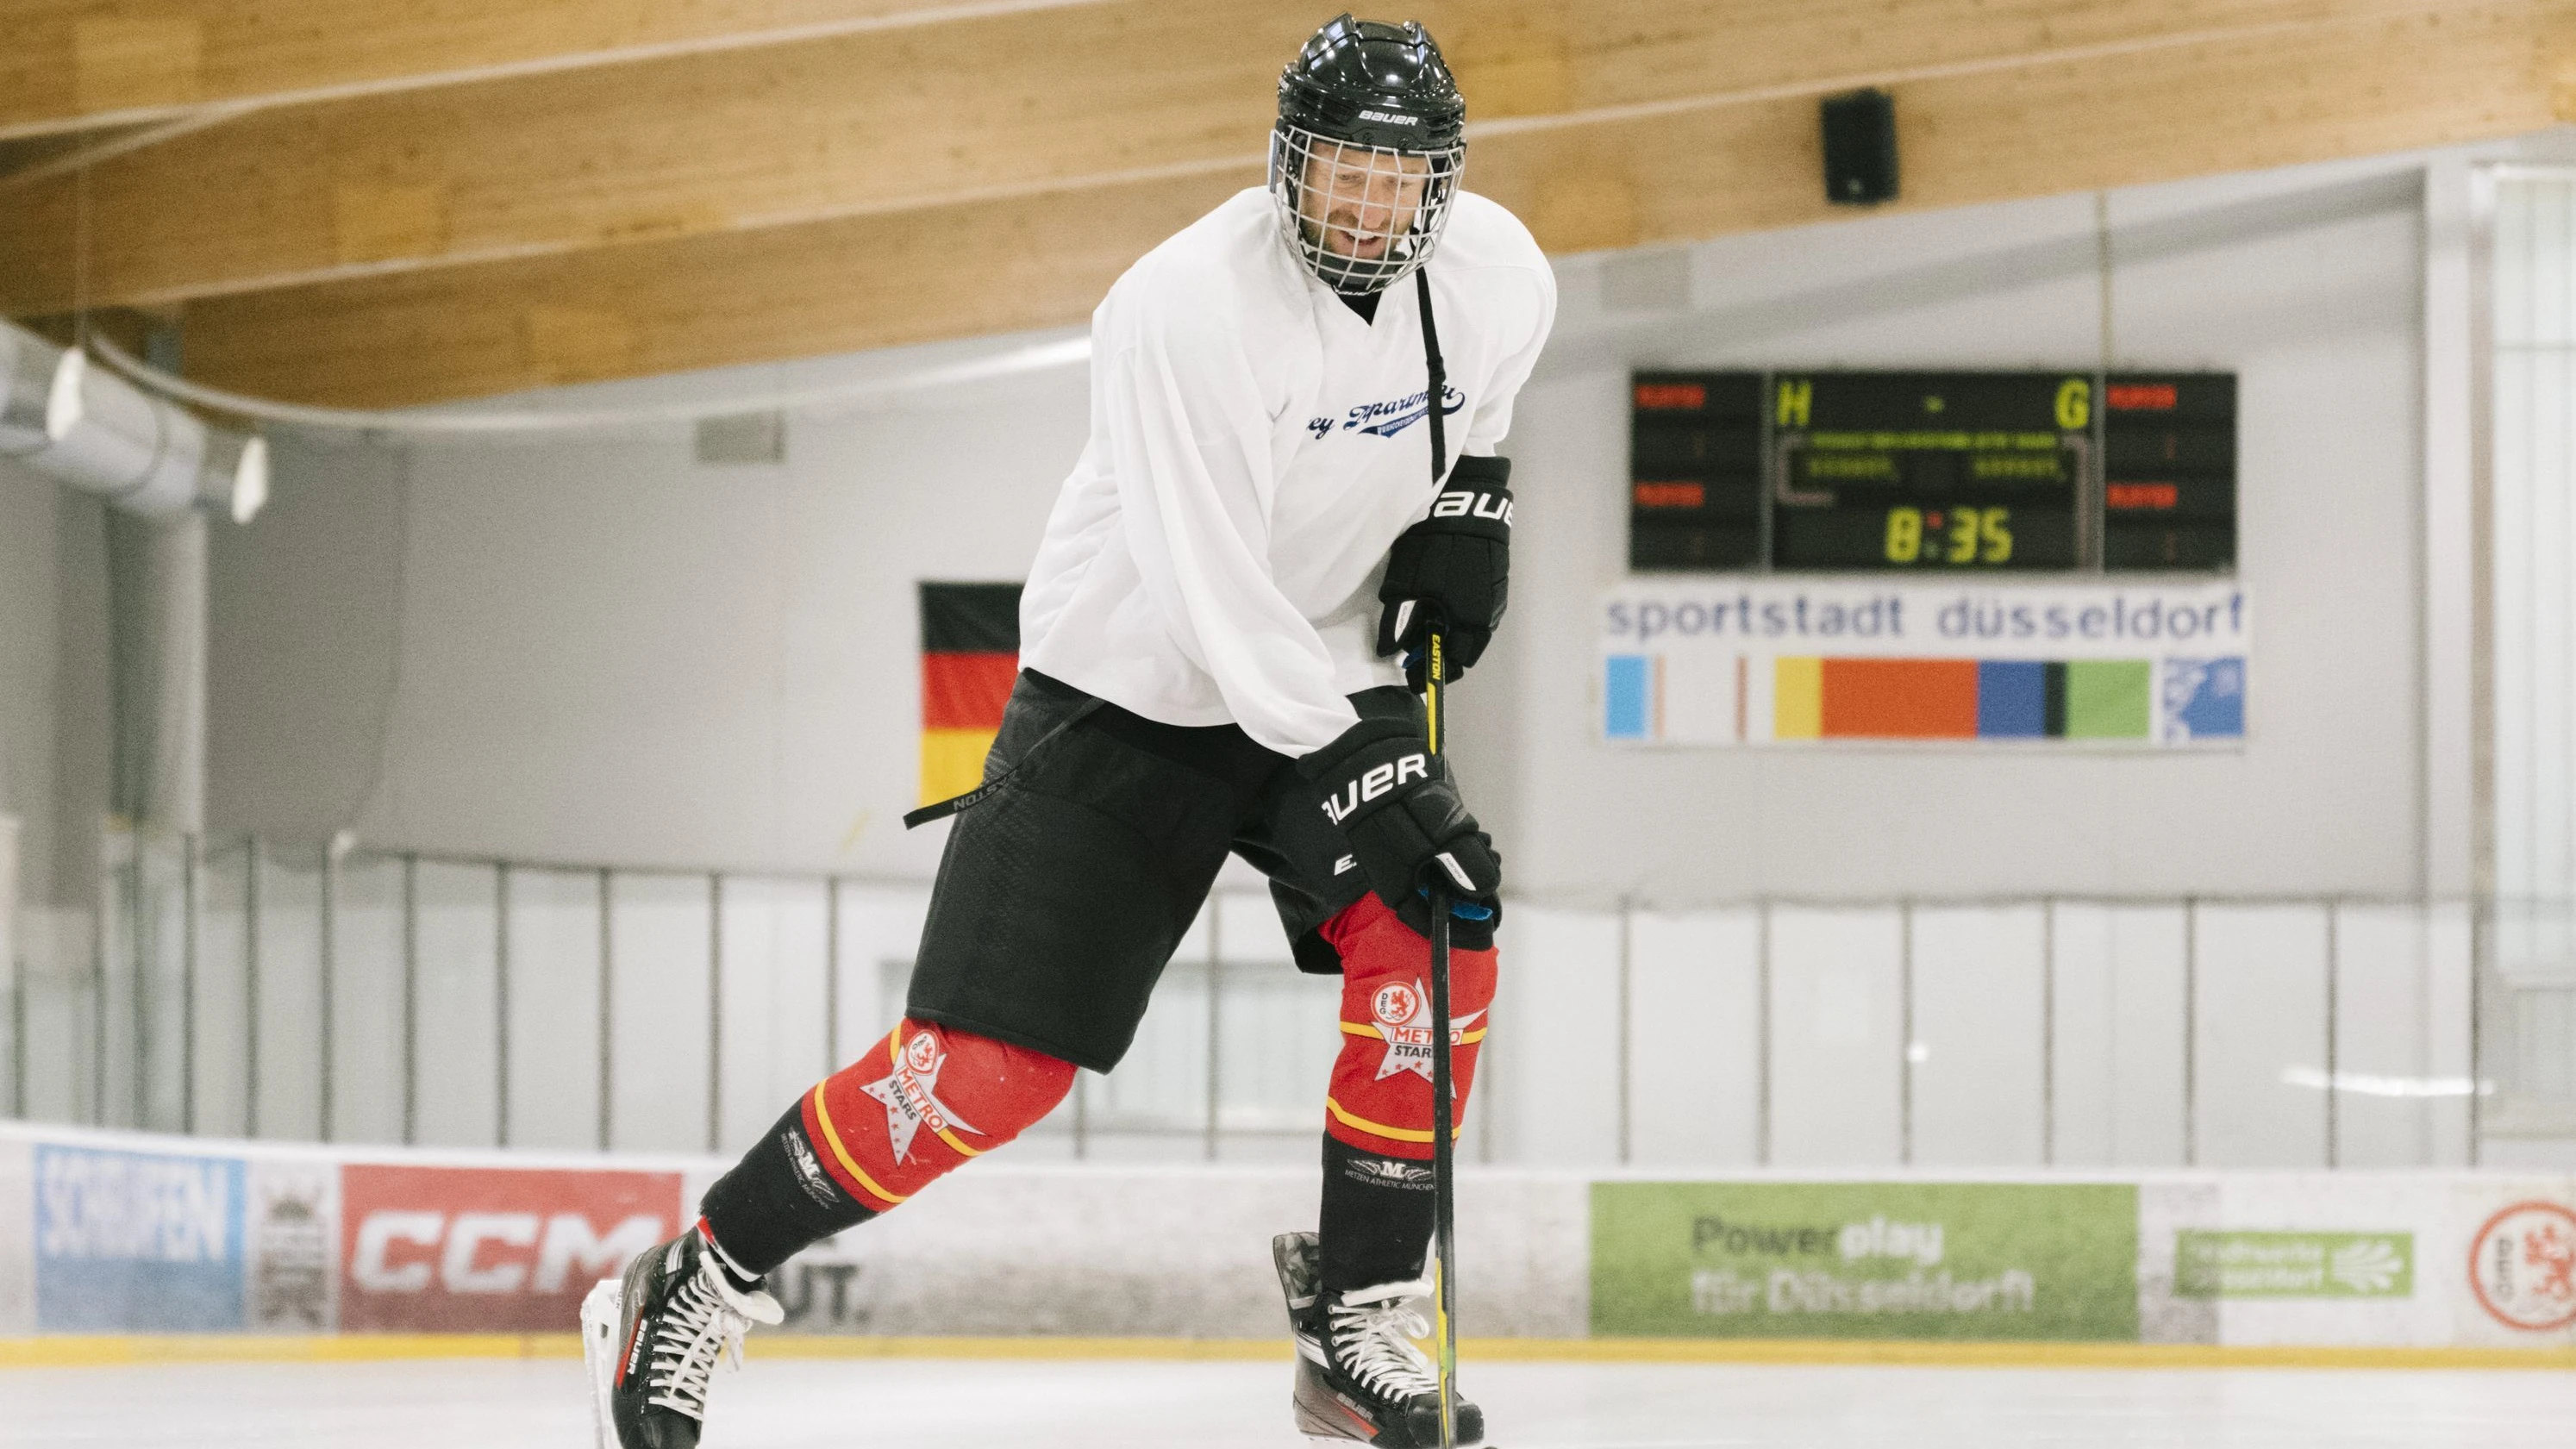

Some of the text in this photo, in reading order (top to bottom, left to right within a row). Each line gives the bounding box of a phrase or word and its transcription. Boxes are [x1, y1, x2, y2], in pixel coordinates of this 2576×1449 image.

[1359, 109, 1418, 126] BAUER
[1777, 379, 2090, 429] H G
[1885, 508, 2012, 563] 8:35
[1606, 593, 1904, 643] sportstadt
[1432, 634, 1441, 681] EASTON
[953, 776, 1008, 811] ASTON
[1379, 992, 1389, 1015] DEG
[1393, 1026, 1460, 1045] METO
[1394, 1045, 1432, 1059] STAR
[888, 1079, 916, 1121] STARS
[897, 1068, 943, 1129] METRO
[351, 1209, 666, 1293] CCM
[1691, 1215, 1943, 1266] Powerplay
[627, 1318, 647, 1375] BAUER
